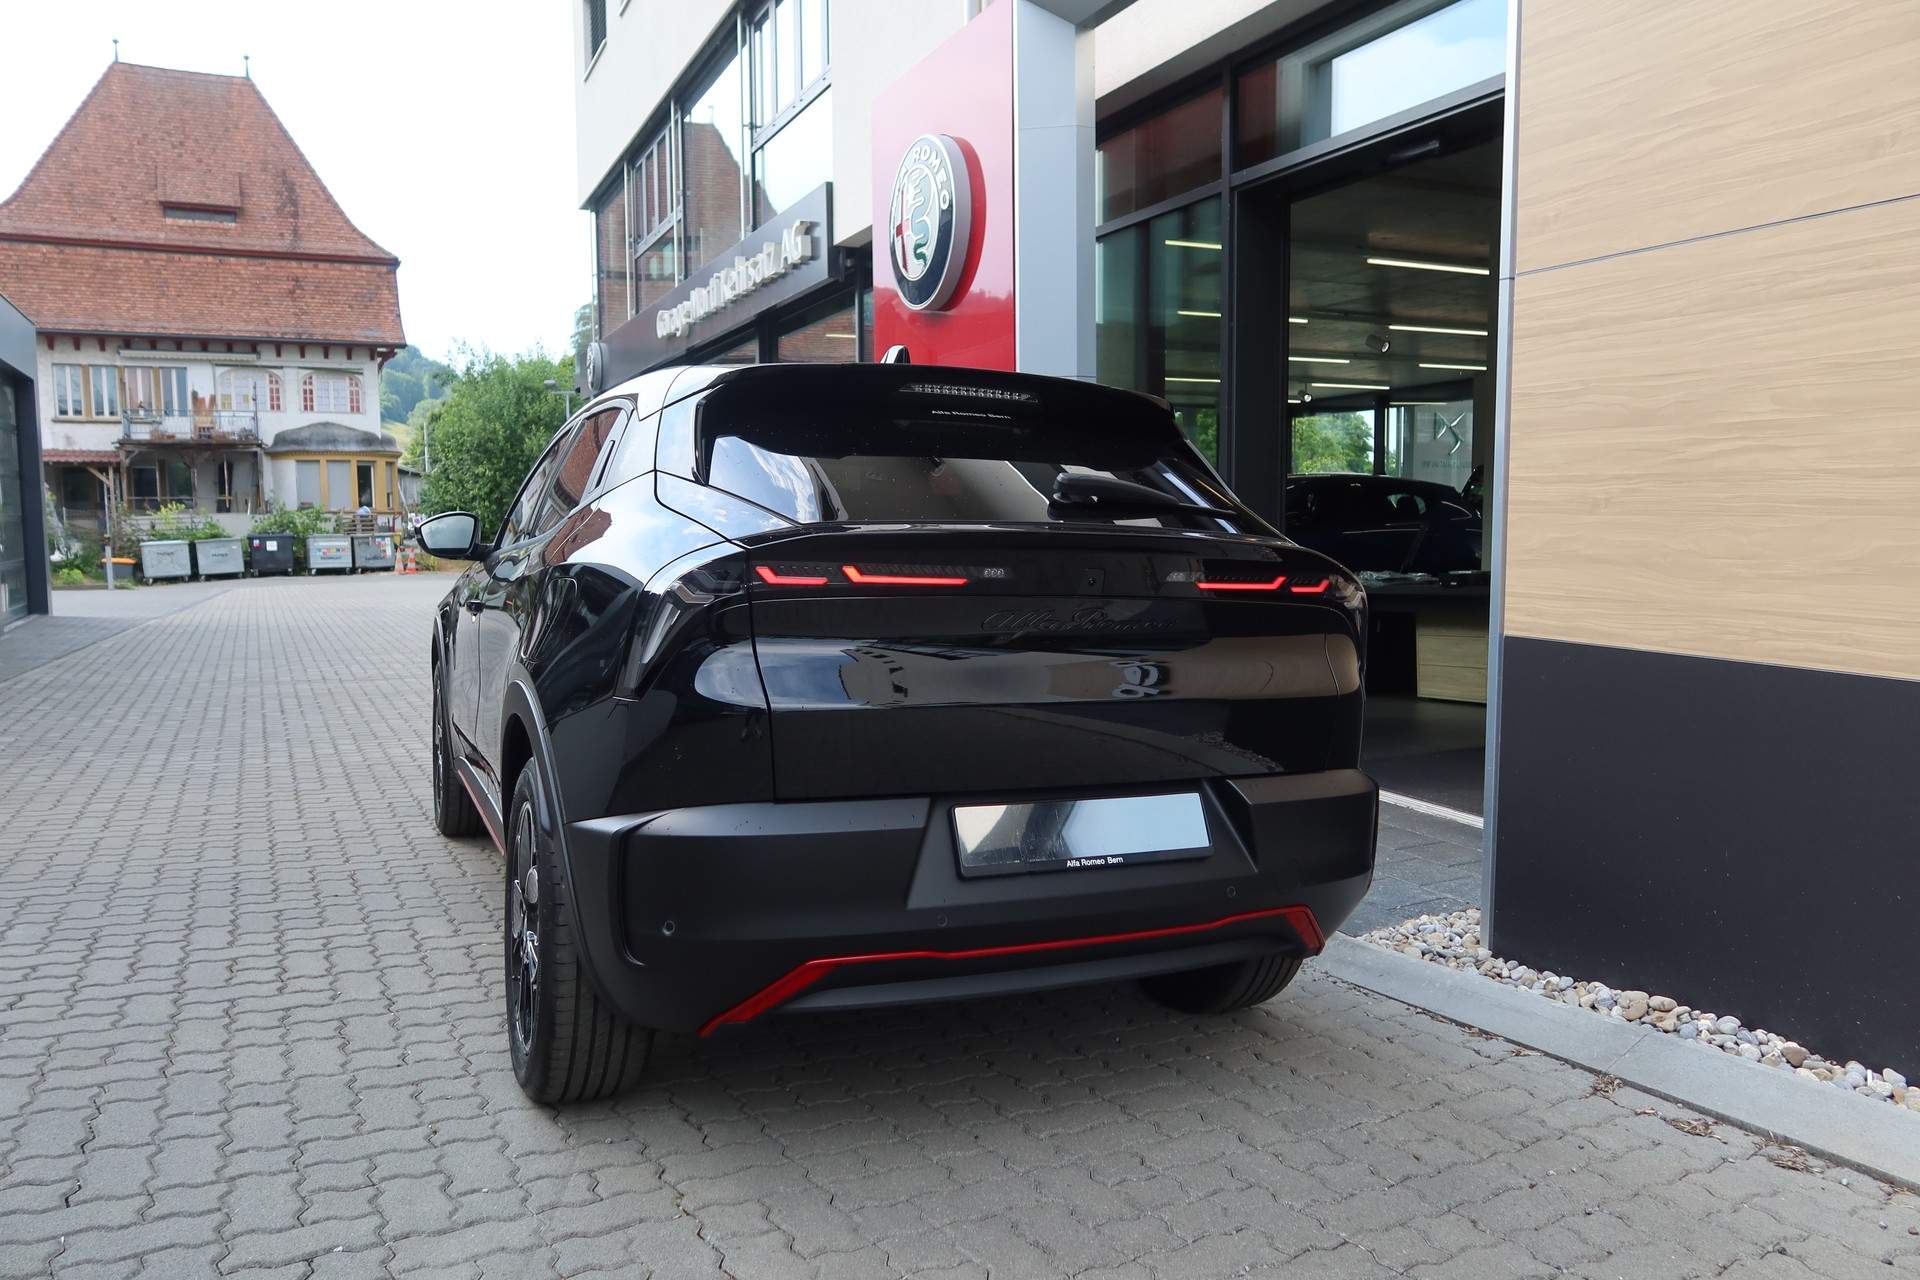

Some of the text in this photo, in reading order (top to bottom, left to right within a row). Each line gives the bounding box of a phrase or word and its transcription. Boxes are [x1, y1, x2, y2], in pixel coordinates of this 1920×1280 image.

[911, 144, 950, 210] ROMEO
[656, 301, 694, 339] Garage
[780, 219, 812, 268] AG
[980, 607, 1180, 640] Alfa Romeo
[1066, 856, 1124, 868] Alfa Romeo Bern
